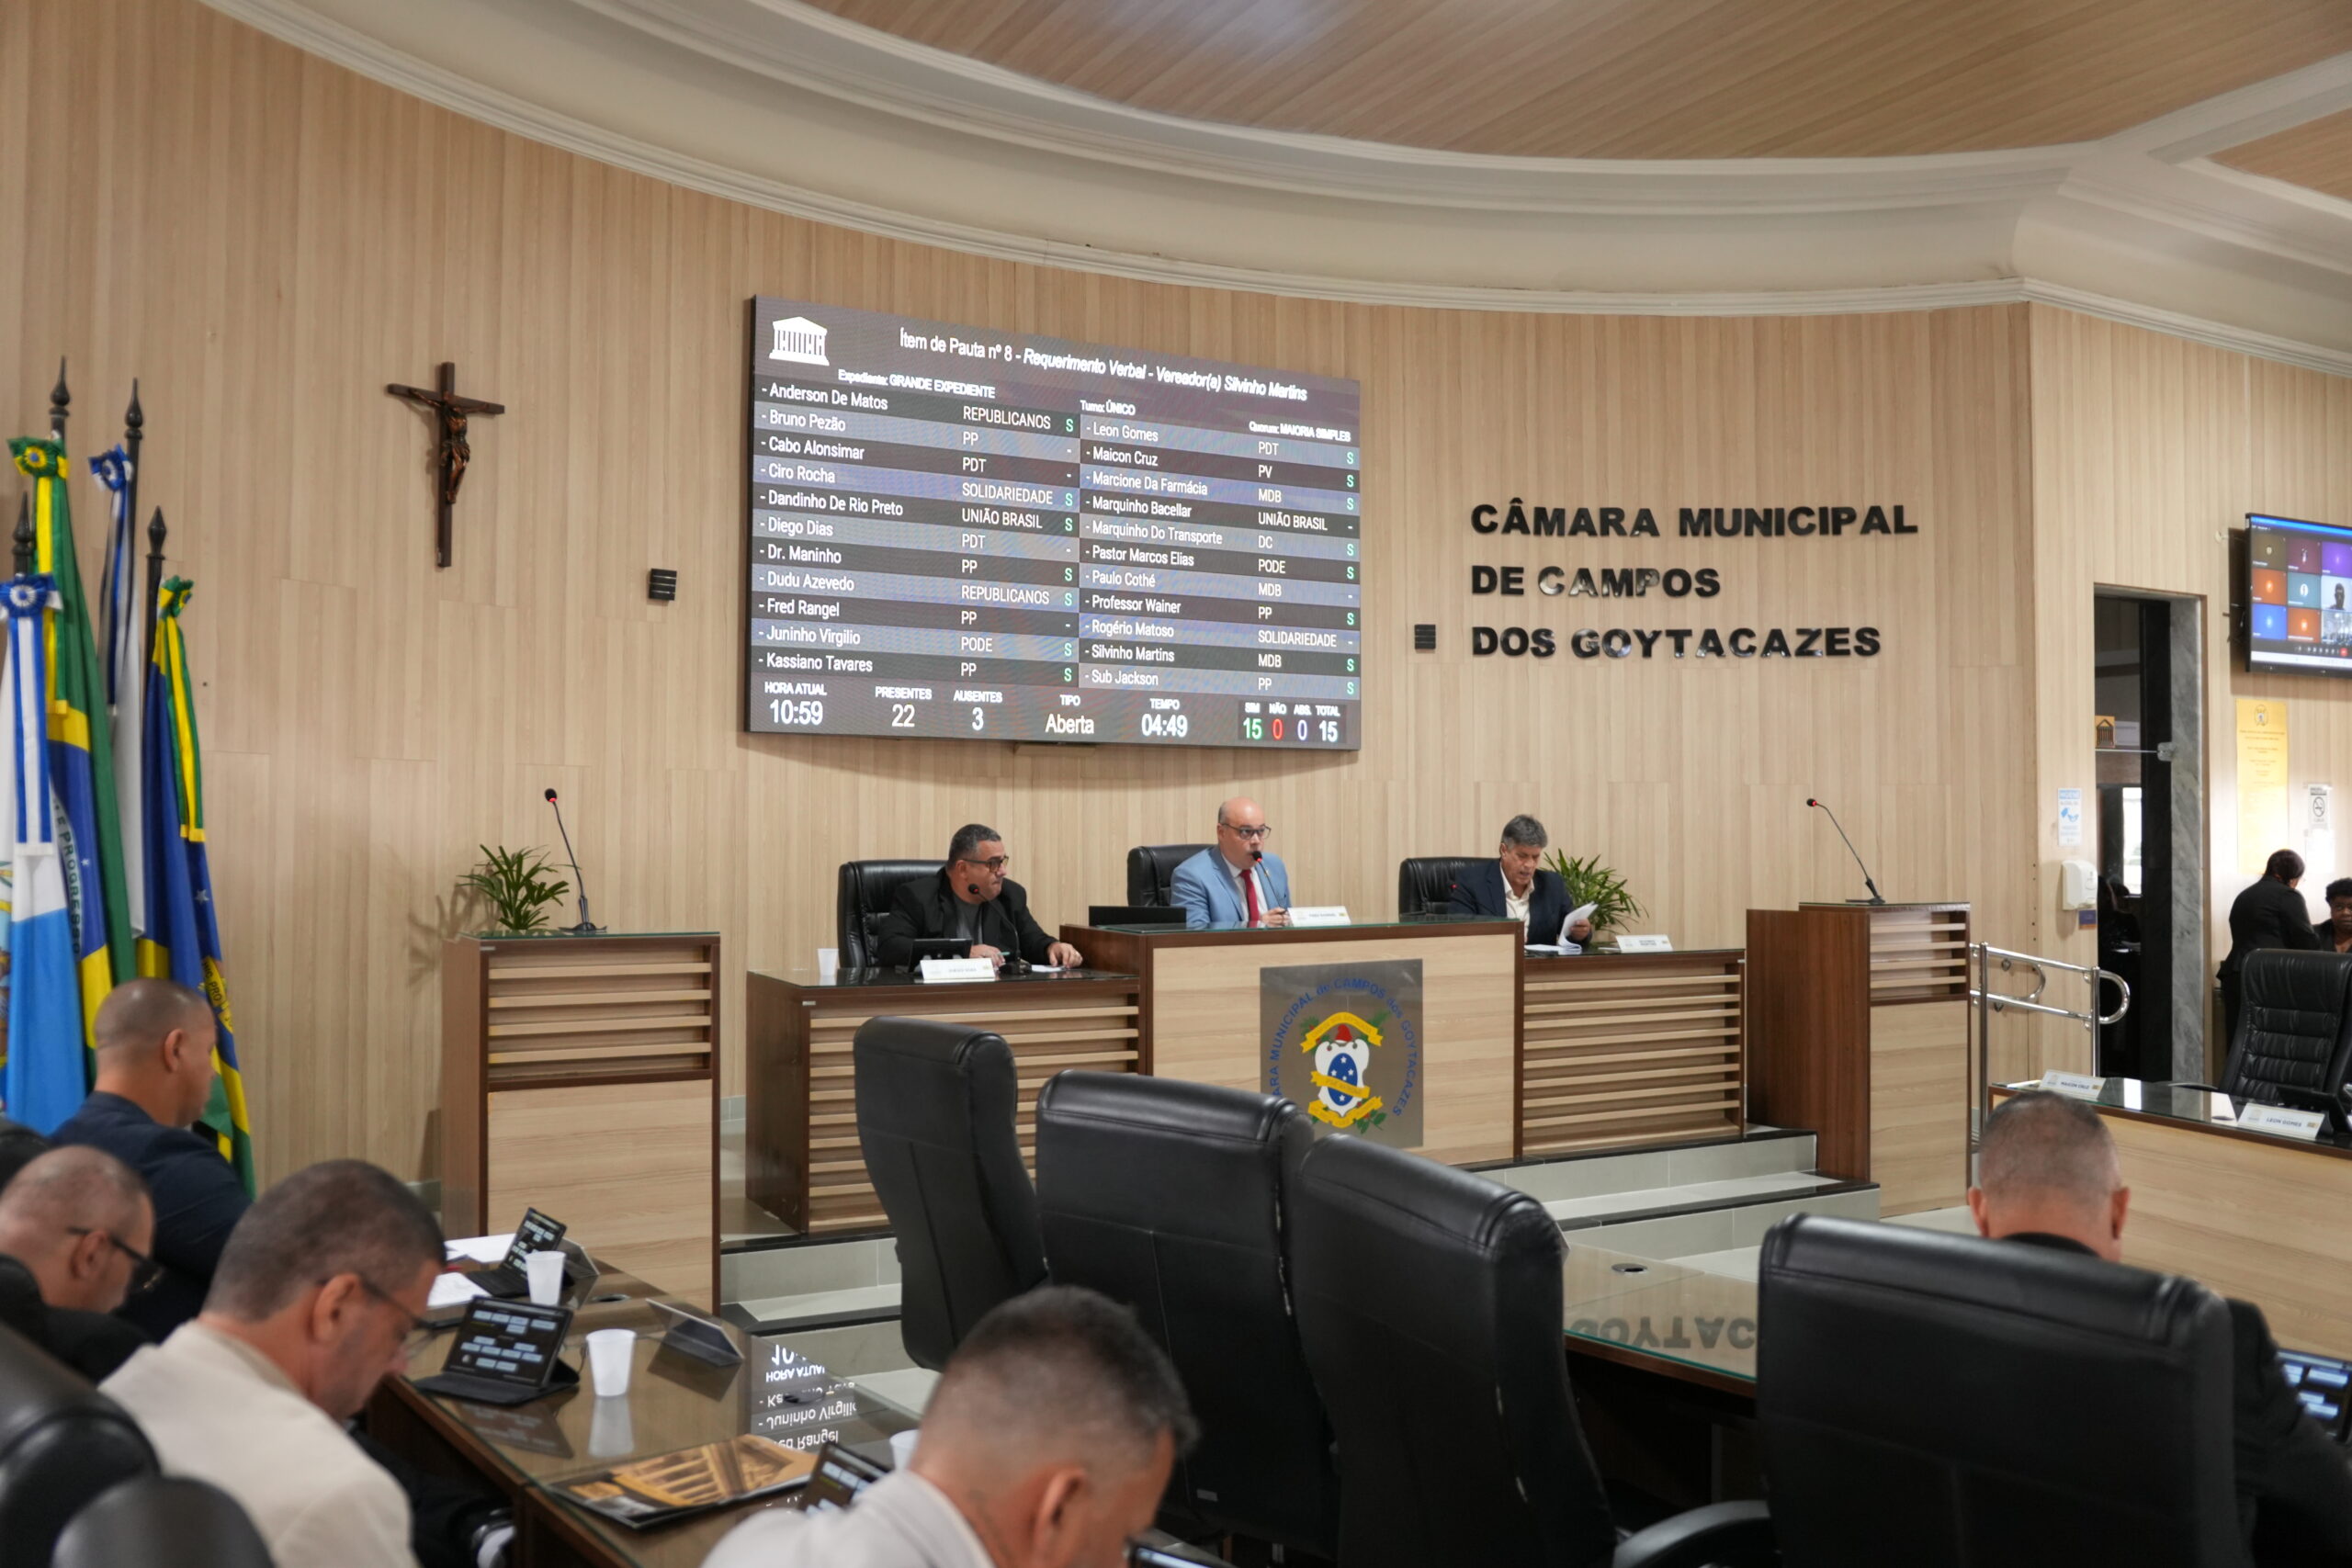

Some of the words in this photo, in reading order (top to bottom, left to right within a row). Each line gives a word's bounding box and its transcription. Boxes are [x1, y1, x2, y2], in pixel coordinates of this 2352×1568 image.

[899, 326, 928, 350] Ítem
[930, 334, 947, 353] de
[949, 337, 986, 358] Pauta
[1003, 344, 1012, 362] 8
[1023, 347, 1107, 375] Requerimento
[1108, 359, 1148, 380] Verbal
[1156, 365, 1222, 393] Vereador(a)
[1224, 375, 1267, 396] Silvinho
[1267, 381, 1307, 401] Martins
[838, 368, 889, 386] Expediente:
[888, 373, 933, 391] GRANDE
[933, 378, 996, 399] EXPEDIENTE
[769, 382, 829, 403] Anderson
[831, 389, 848, 406] De
[851, 391, 888, 411] Matos
[1105, 399, 1136, 416] ÚNICO
[770, 409, 807, 428] Bruno
[808, 412, 846, 433] Pezão
[963, 405, 1051, 430] REPUBLICANOS
[1066, 418, 1074, 433] S
[963, 431, 979, 446] PP
[1093, 422, 1120, 438] Leon
[1121, 424, 1159, 443] Gomes
[1280, 423, 1316, 438] MAIORIA
[1315, 427, 1351, 443] SIMPLES
[768, 435, 801, 454] Cabo
[803, 439, 865, 460] Alonsimar
[1092, 446, 1132, 464] Maicon
[1134, 450, 1159, 467] Cruz
[1258, 441, 1279, 457] PDT
[962, 457, 987, 473] PDT
[1346, 451, 1354, 465] S
[768, 462, 794, 479] Ciro
[797, 465, 835, 484] Rocha
[1258, 464, 1272, 479] PV
[1092, 470, 1142, 490] Marcione
[1144, 476, 1159, 491] Da
[1160, 478, 1208, 496] Farmácia
[1346, 474, 1354, 488] S
[962, 481, 1053, 505] SOLIDARIEDADE
[1065, 492, 1073, 507] S
[1258, 488, 1282, 503] MDB
[768, 489, 827, 510] Dandinho
[830, 494, 847, 512] De
[849, 496, 868, 513] Rio
[871, 498, 903, 516] Preto
[1092, 495, 1149, 514] Marquinho
[1150, 501, 1193, 518] Bacellar
[1346, 497, 1354, 511] S
[962, 507, 1000, 525] UNIÃO
[1002, 511, 1044, 529] BRASIL
[1064, 517, 1073, 532] S
[1258, 511, 1291, 527] UNIÃO
[1293, 514, 1329, 531] BRASIL
[1470, 497, 1660, 537] CÂMARA
[1679, 505, 1918, 537] MUNICIPAL
[768, 516, 804, 537] Diego
[807, 519, 833, 536] Dias
[1092, 519, 1149, 539] Marquinho
[1150, 525, 1166, 540] Do
[1167, 526, 1223, 546] Transporte
[962, 533, 986, 549] PDT
[1258, 535, 1273, 549] DC
[1346, 543, 1354, 557] S
[767, 543, 786, 560] Dr.
[788, 545, 842, 564] Maninho
[1092, 544, 1128, 561] Pastor
[1129, 547, 1169, 565] Marcos
[1170, 550, 1194, 567] Elias
[961, 558, 978, 574] PP
[1064, 567, 1073, 582] S
[1258, 558, 1286, 574] PODE
[1346, 566, 1354, 580] S
[767, 570, 800, 588] Dudu
[802, 573, 854, 592] Azevedo
[1091, 570, 1123, 586] Paulo
[1124, 572, 1156, 588] Cothé
[1471, 565, 1524, 595] DE
[1538, 566, 1721, 597] CAMPOS
[961, 584, 1050, 605] REPUBLICANOS
[1258, 581, 1282, 597] MDB
[767, 597, 796, 615] Fred
[797, 599, 840, 620] Rangel
[1064, 592, 1073, 607] S
[1091, 593, 1143, 612] Professor
[1145, 598, 1182, 614] Wainer
[961, 610, 978, 626] PP
[1258, 605, 1272, 619] PP
[1346, 612, 1355, 626] S
[765, 625, 817, 643] Juninho
[819, 627, 861, 648] Virgilio
[1091, 618, 1133, 637] Rogério
[1135, 622, 1174, 637] Matoso
[961, 636, 993, 652] PODE
[1258, 629, 1337, 648] SOLIDARIEDADE
[1471, 626, 1555, 658] DOS
[1570, 627, 1881, 659] GOYTACAZES
[1064, 642, 1072, 657] S
[1091, 643, 1133, 660] Silvinho
[1135, 646, 1175, 662] Martins
[766, 651, 823, 671] Kassiano
[825, 655, 873, 672] Tavares
[960, 661, 977, 677] PP
[1258, 653, 1282, 668] MDB
[1346, 658, 1355, 672] S
[1064, 667, 1072, 682] S
[1091, 669, 1113, 684] Sub
[1114, 670, 1159, 686] Jackson
[764, 681, 795, 695] HORA
[794, 682, 828, 696] ATUAL
[875, 685, 933, 700] PRESENTES
[1258, 677, 1272, 691] PP
[1346, 681, 1355, 695] S
[953, 689, 1003, 704] AUSENTES
[1059, 694, 1081, 706] TIPO
[1149, 697, 1181, 711] TEMPO
[770, 699, 823, 726] 10:59
[891, 704, 915, 728] 22
[1244, 702, 1261, 714] SIM
[1269, 702, 1287, 715] NÃO
[1293, 704, 1312, 716] ABS.
[1315, 705, 1340, 717] TOTAL
[971, 706, 985, 731] 3
[1045, 713, 1094, 735] Aberta
[1141, 713, 1188, 738] 04:49
[1243, 717, 1262, 740] 15
[1272, 718, 1283, 740] 0
[1296, 719, 1308, 741] 0
[1318, 719, 1339, 743] 15
[59, 830, 82, 954] PROGRESSO
[1270, 993, 1313, 1061] MUNICIPAL
[1334, 978, 1385, 998] CAMPOS
[1392, 1020, 1418, 1116] GOYTACAZES
